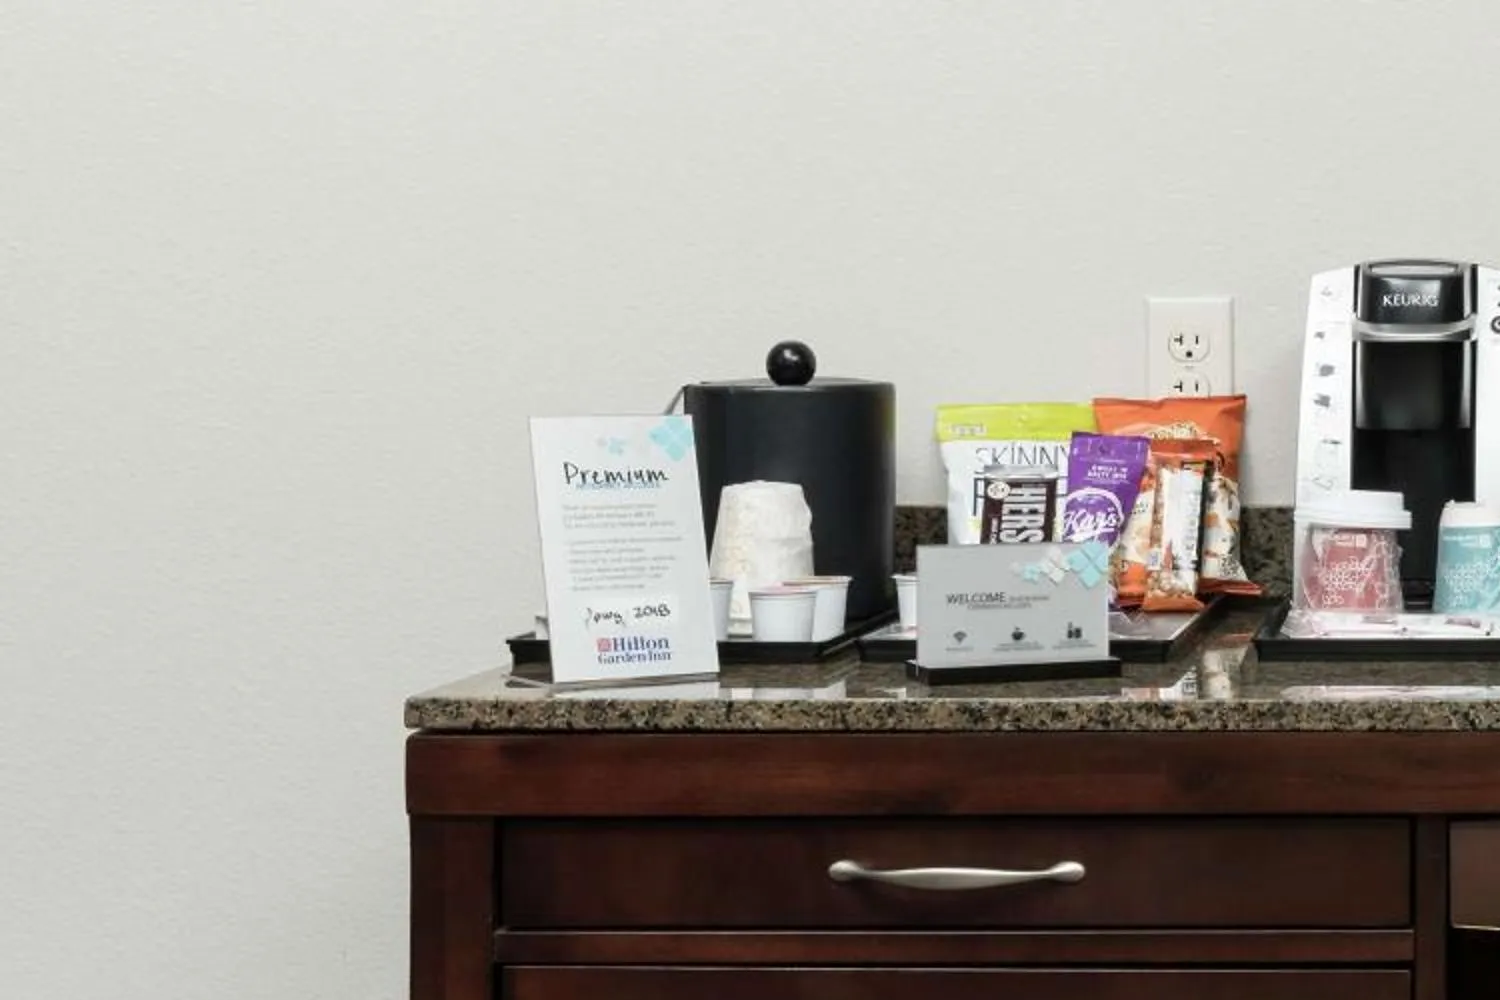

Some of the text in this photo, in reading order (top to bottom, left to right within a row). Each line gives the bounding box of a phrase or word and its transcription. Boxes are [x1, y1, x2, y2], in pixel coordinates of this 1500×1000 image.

[1383, 294, 1438, 307] KEURIG
[563, 462, 669, 485] Premium
[947, 592, 1005, 604] WELCOME
[612, 636, 670, 651] Hilton
